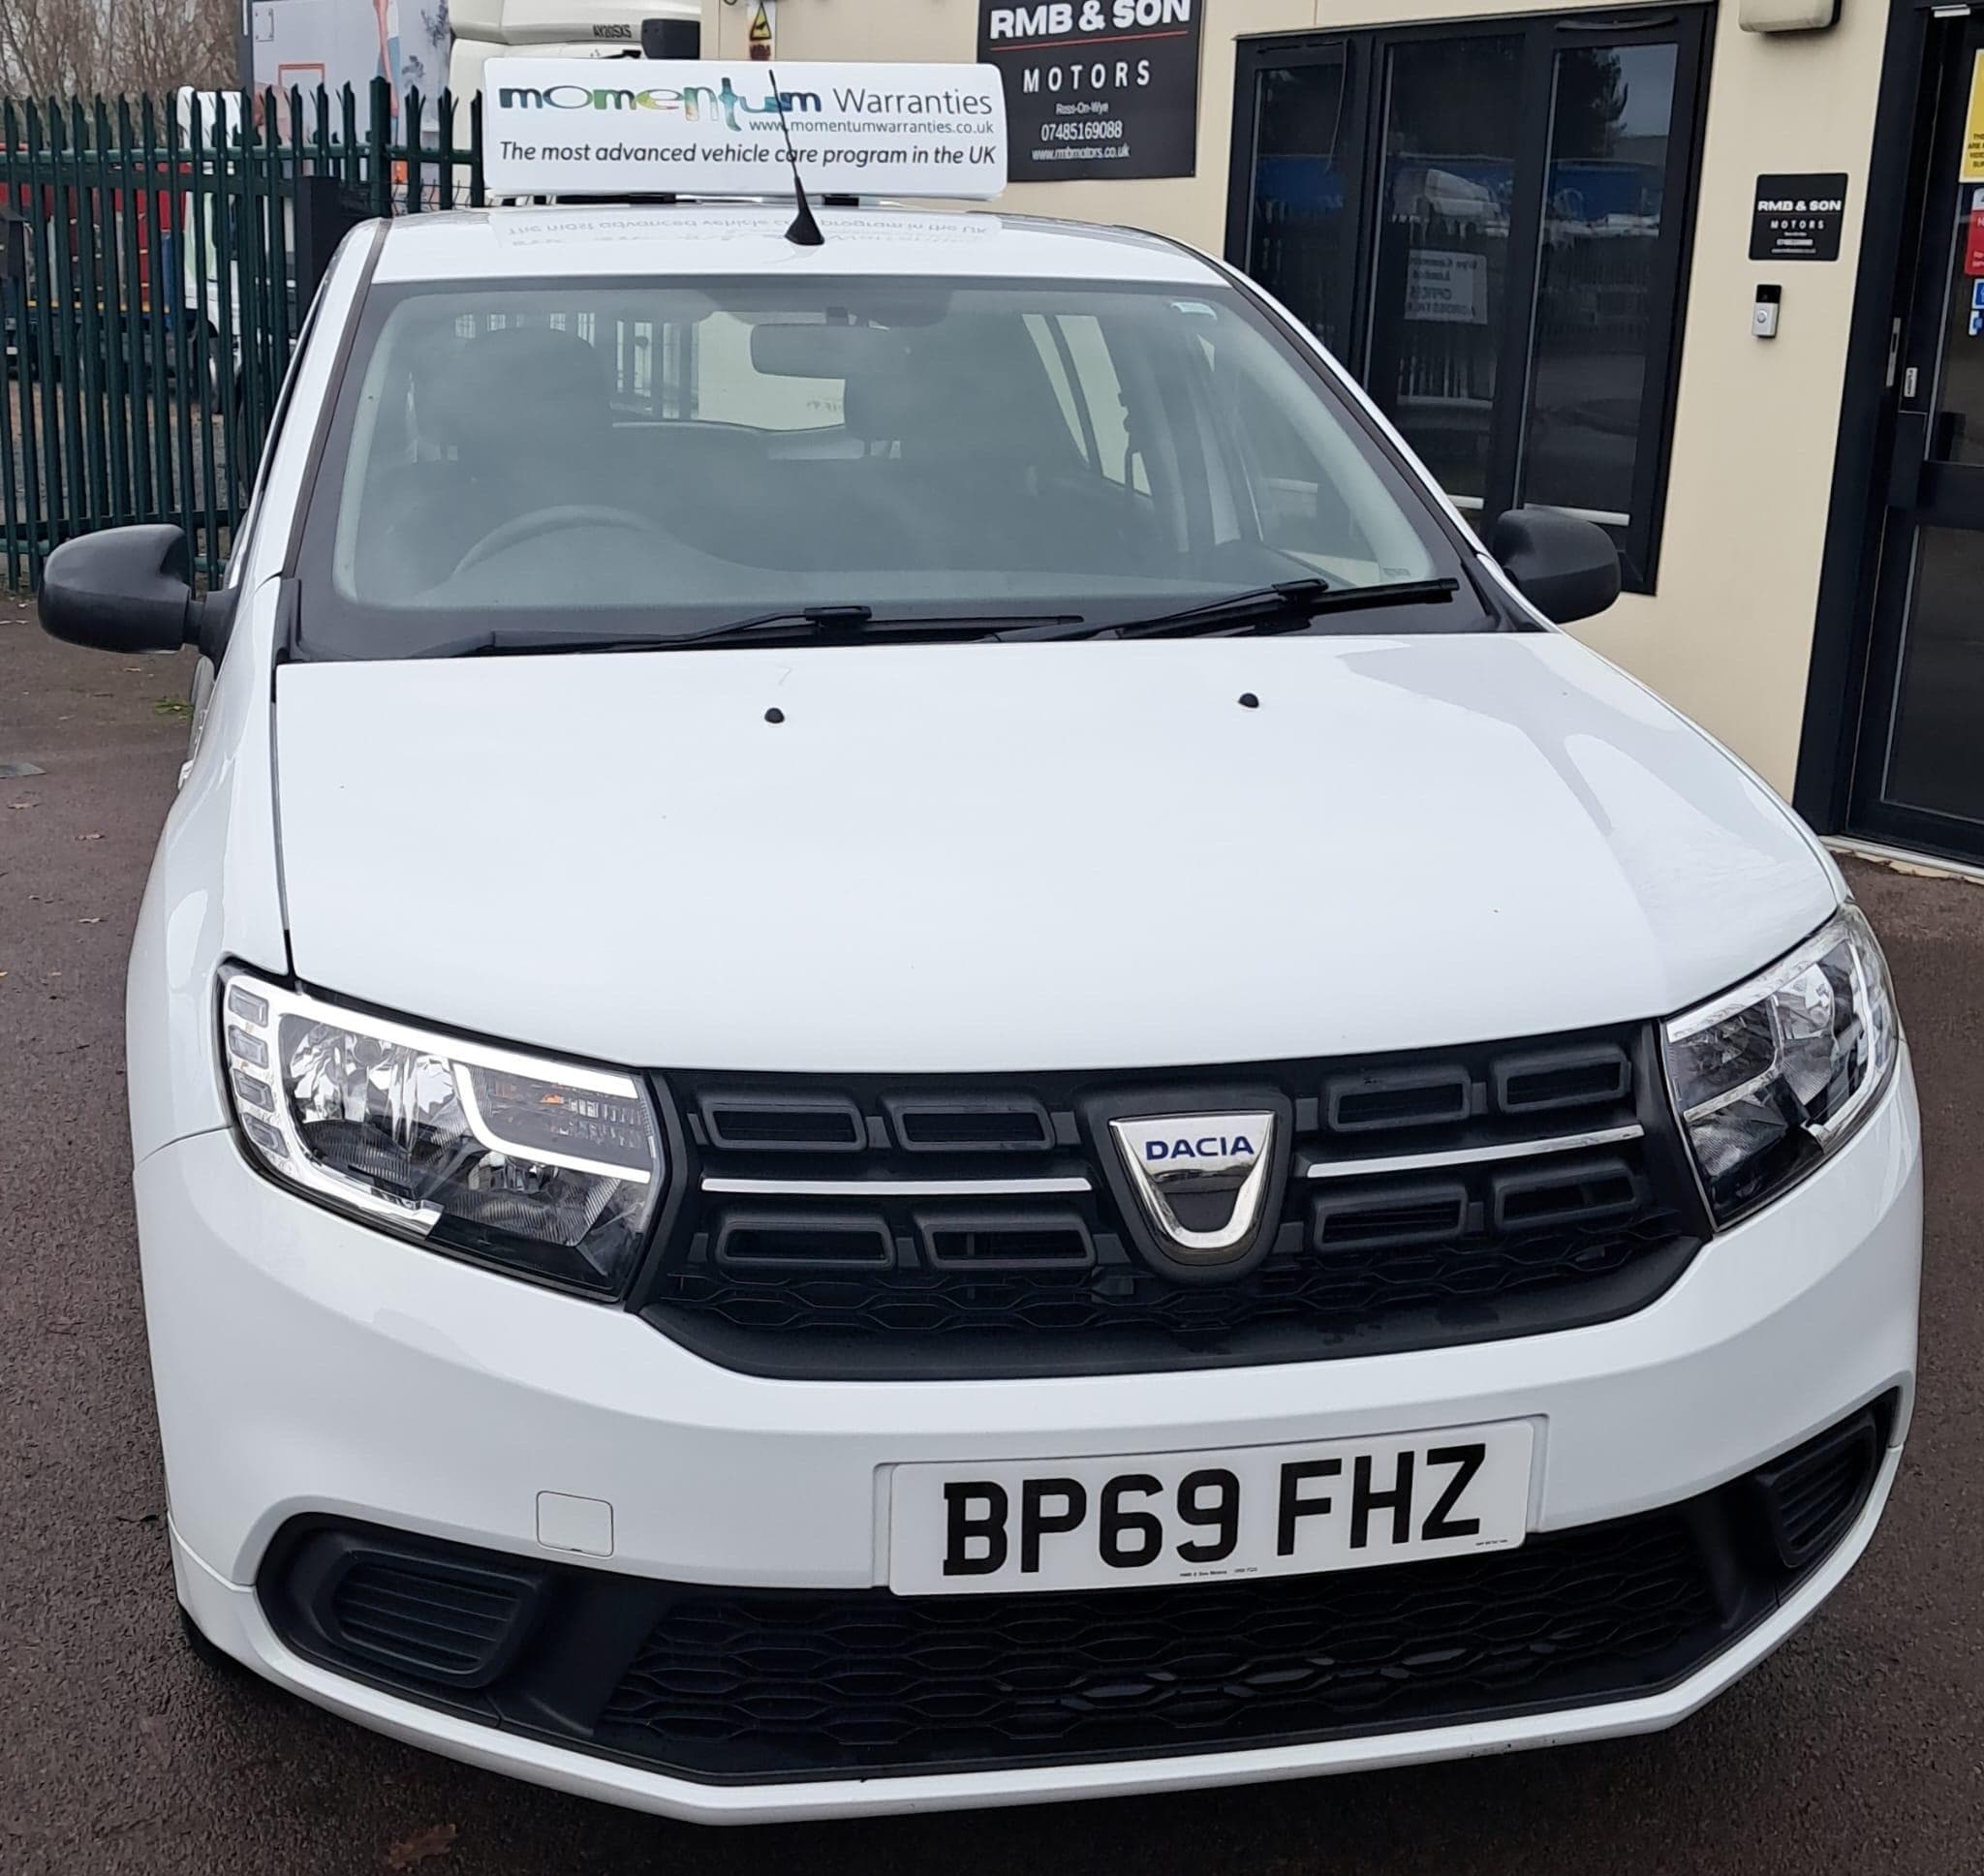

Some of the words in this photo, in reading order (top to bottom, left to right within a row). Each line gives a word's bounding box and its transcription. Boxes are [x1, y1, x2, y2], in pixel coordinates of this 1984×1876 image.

[990, 3, 1072, 40] RMB
[1078, 0, 1105, 31] &
[1113, 0, 1191, 28] SON
[1023, 59, 1150, 93] MOTORS
[499, 77, 822, 132] momentum
[832, 87, 993, 114] Warranties
[749, 119, 995, 135] www.momentumwarranties.co.uk
[1041, 120, 1123, 141] 07485169088
[500, 141, 536, 160] The
[542, 144, 591, 162] most
[596, 142, 697, 163] advanced
[701, 143, 770, 163] vehicle
[776, 148, 819, 165] care
[822, 148, 908, 168] program
[913, 145, 930, 164] in
[934, 146, 964, 165] the
[969, 146, 997, 165] UK
[1809, 200, 1842, 211] SON
[1770, 220, 1824, 230] MOTORS
[1146, 1136, 1255, 1160] DACIA
[943, 1468, 1240, 1576] BP69
[1277, 1443, 1486, 1556] FHZ
